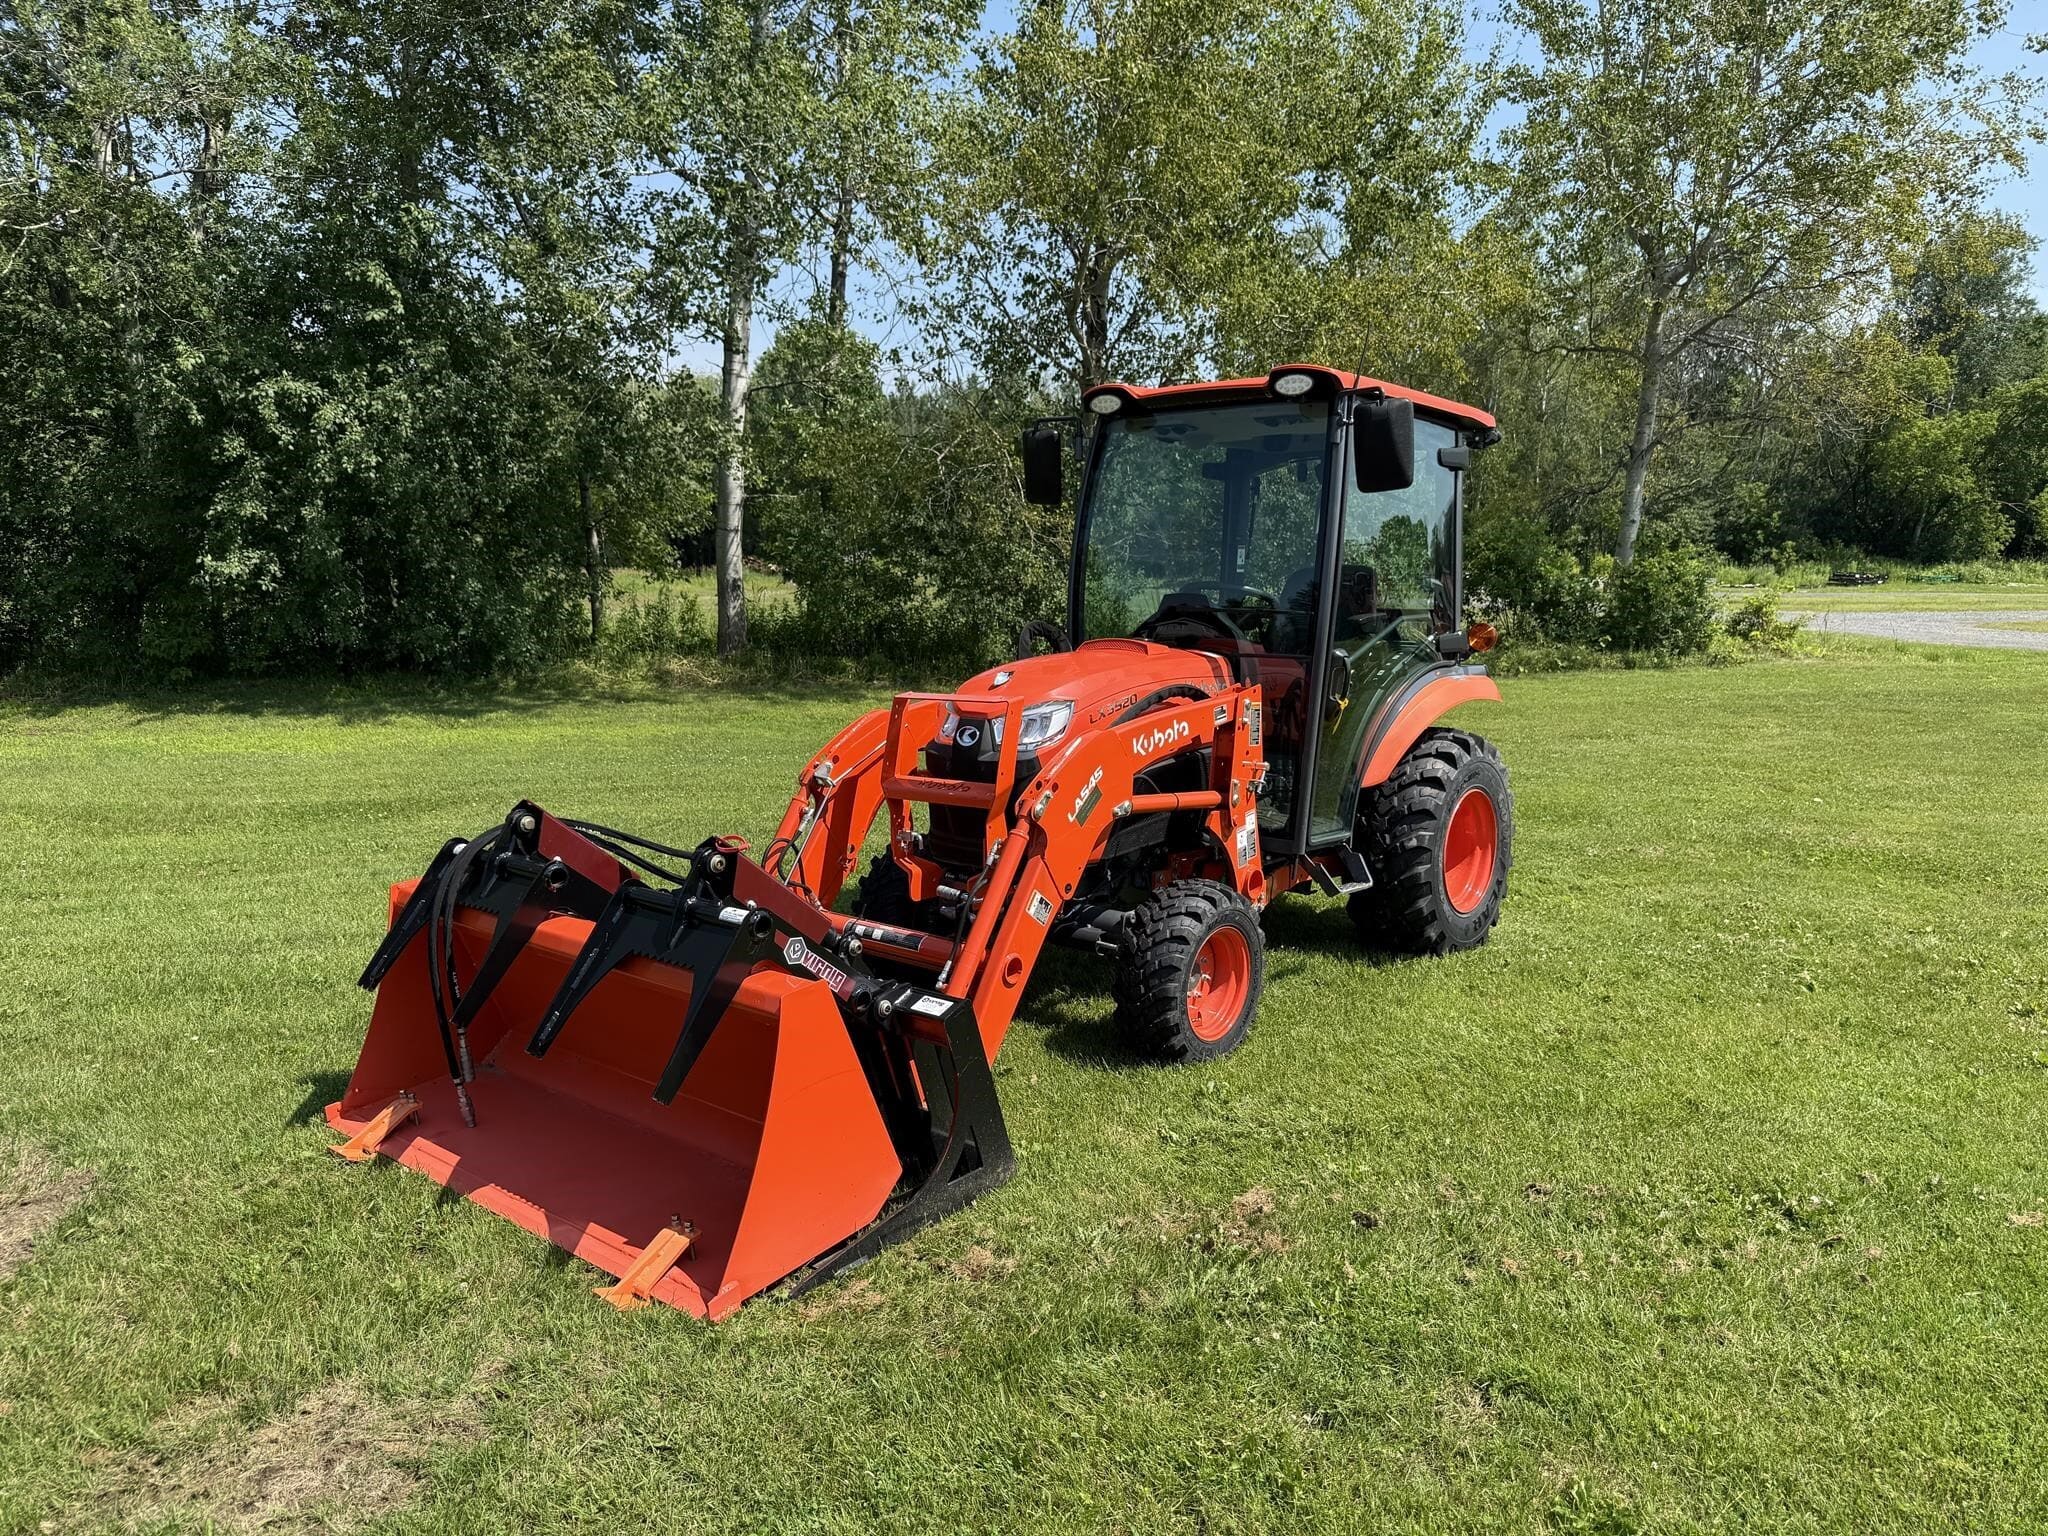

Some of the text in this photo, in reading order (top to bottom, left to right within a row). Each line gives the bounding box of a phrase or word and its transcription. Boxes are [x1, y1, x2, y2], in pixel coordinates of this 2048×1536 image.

[1089, 693, 1138, 724] LX3520
[1132, 719, 1189, 756] Kubota
[1067, 764, 1104, 823] LA545
